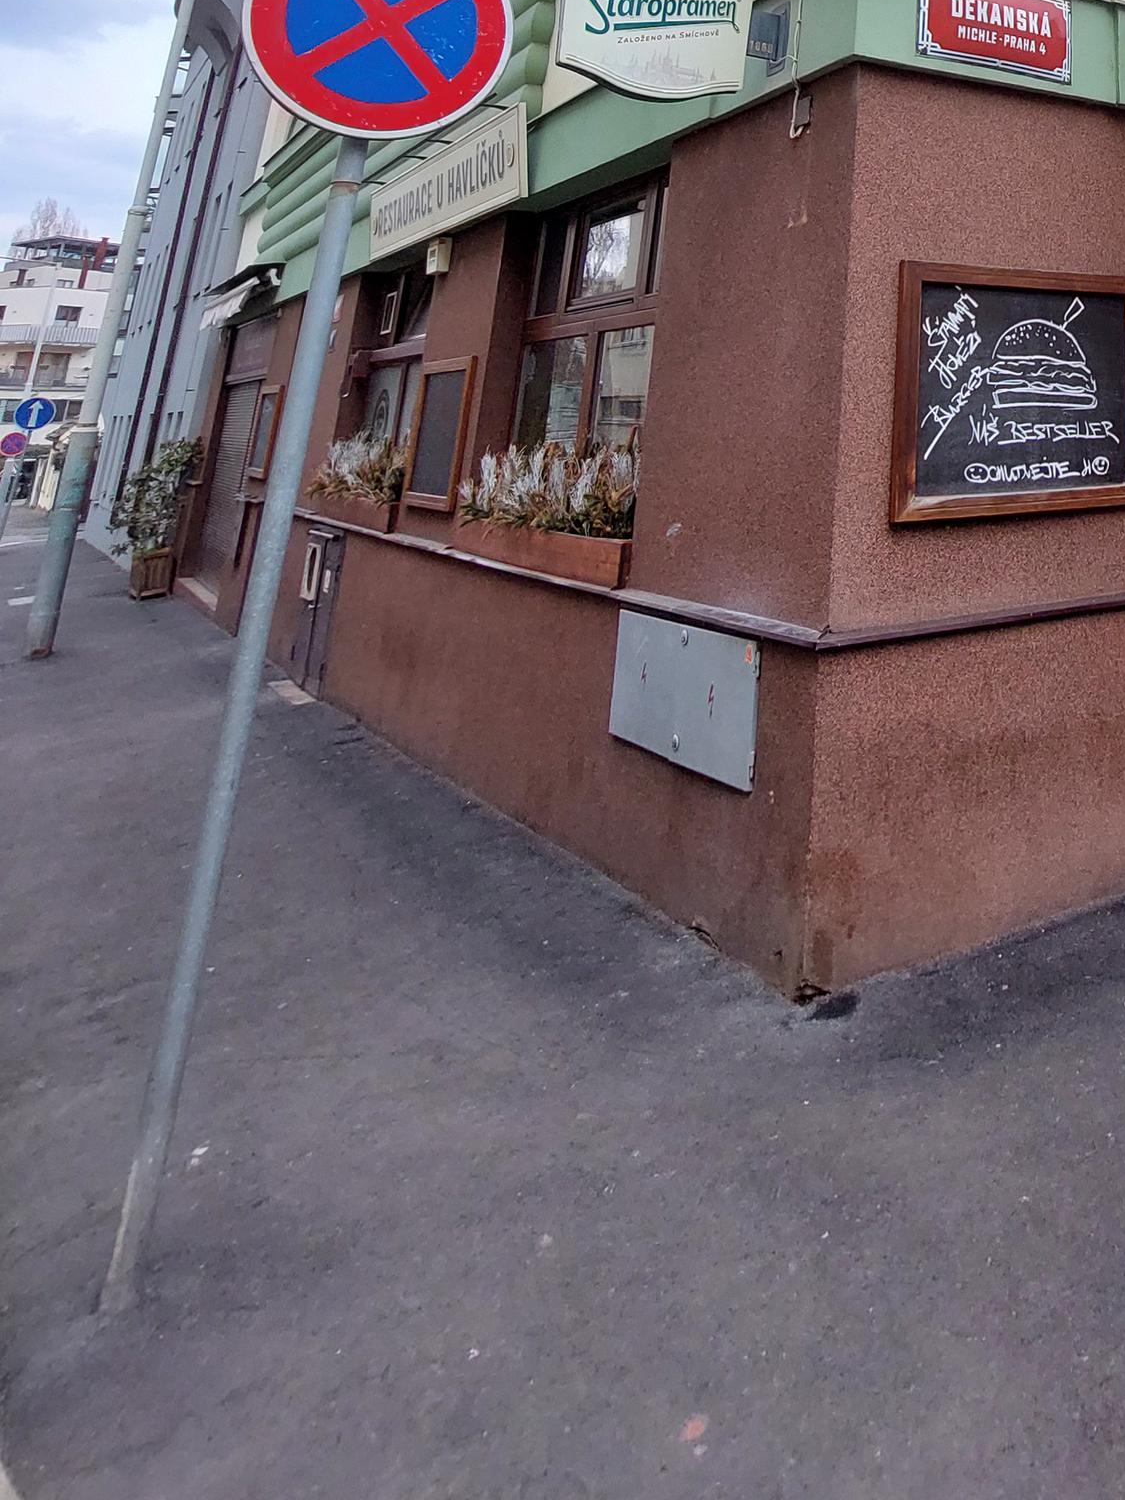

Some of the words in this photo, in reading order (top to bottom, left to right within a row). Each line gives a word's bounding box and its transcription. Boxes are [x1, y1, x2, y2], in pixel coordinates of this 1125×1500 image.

[1038, 42, 1047, 56] 4
[378, 179, 433, 238] RESTAURACE
[436, 175, 445, 208] U
[447, 130, 506, 204] HAVLÍČKŮ
[968, 404, 1000, 447] NÁŠ
[998, 421, 1120, 446] BESTSELLER
